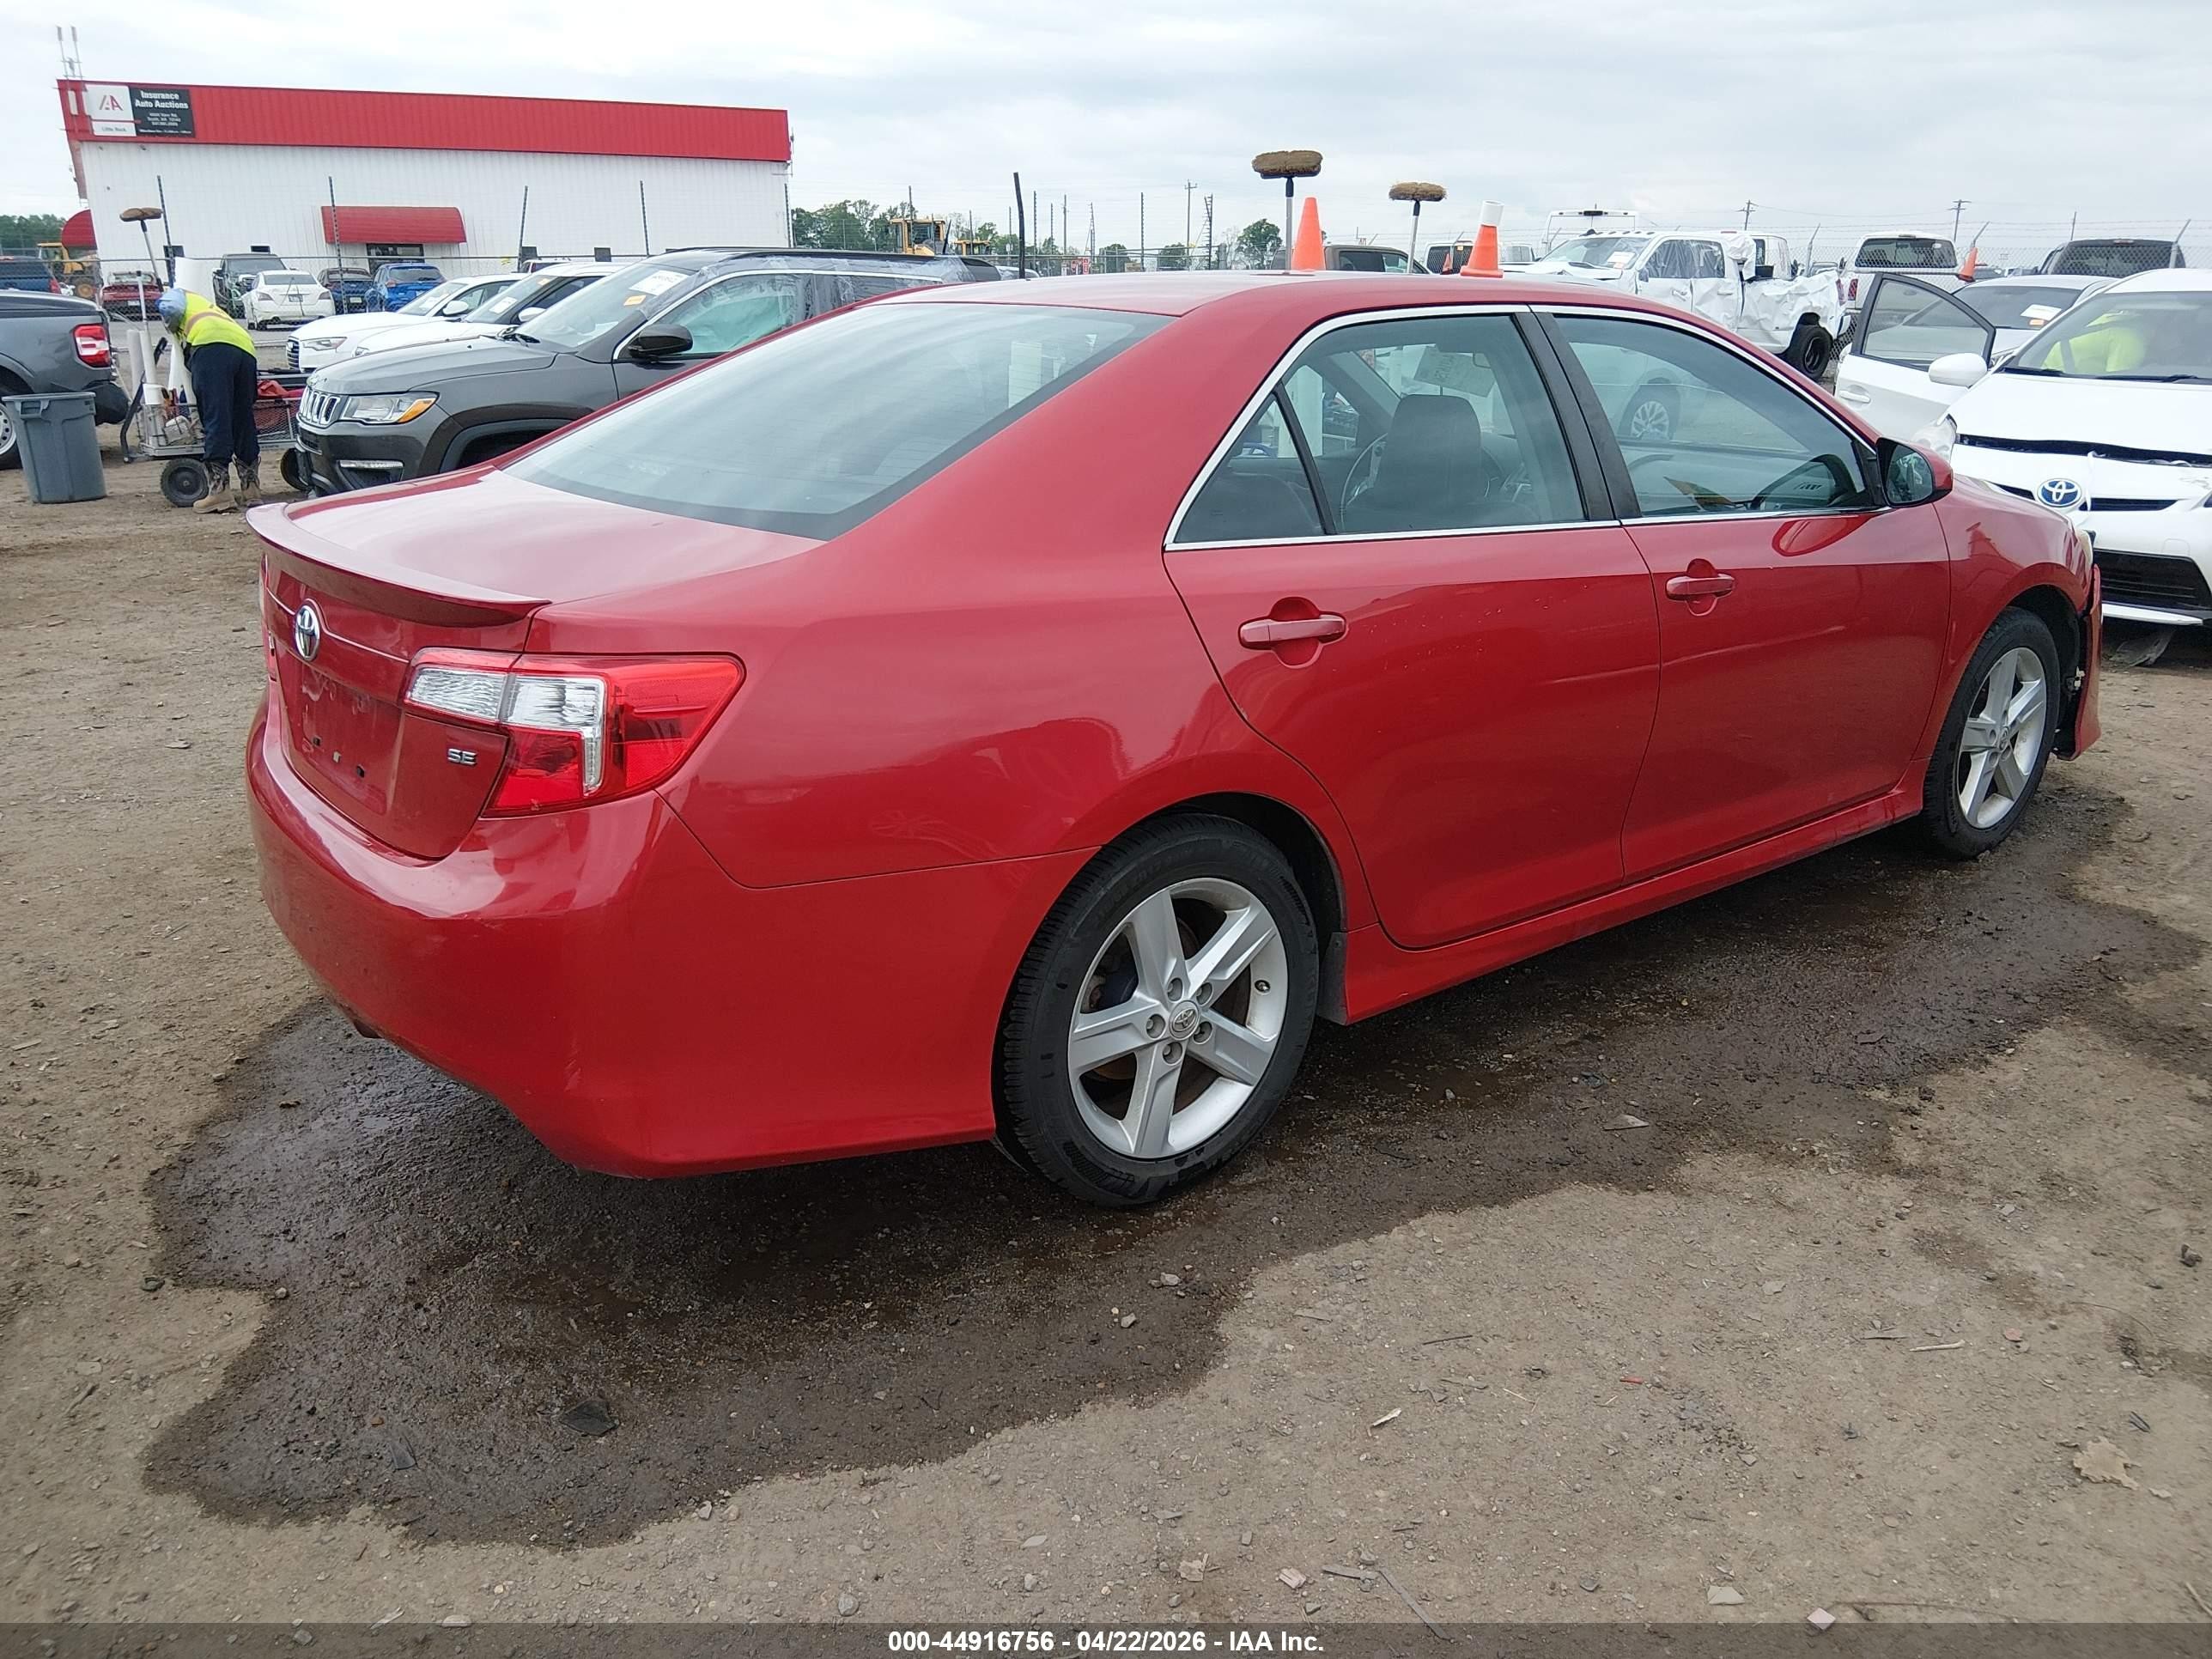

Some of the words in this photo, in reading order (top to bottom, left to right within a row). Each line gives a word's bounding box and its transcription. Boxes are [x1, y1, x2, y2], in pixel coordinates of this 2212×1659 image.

[141, 90, 179, 100] Insurance
[135, 100, 154, 108] Auto
[155, 100, 189, 109] Auctions
[447, 748, 477, 766] SE
